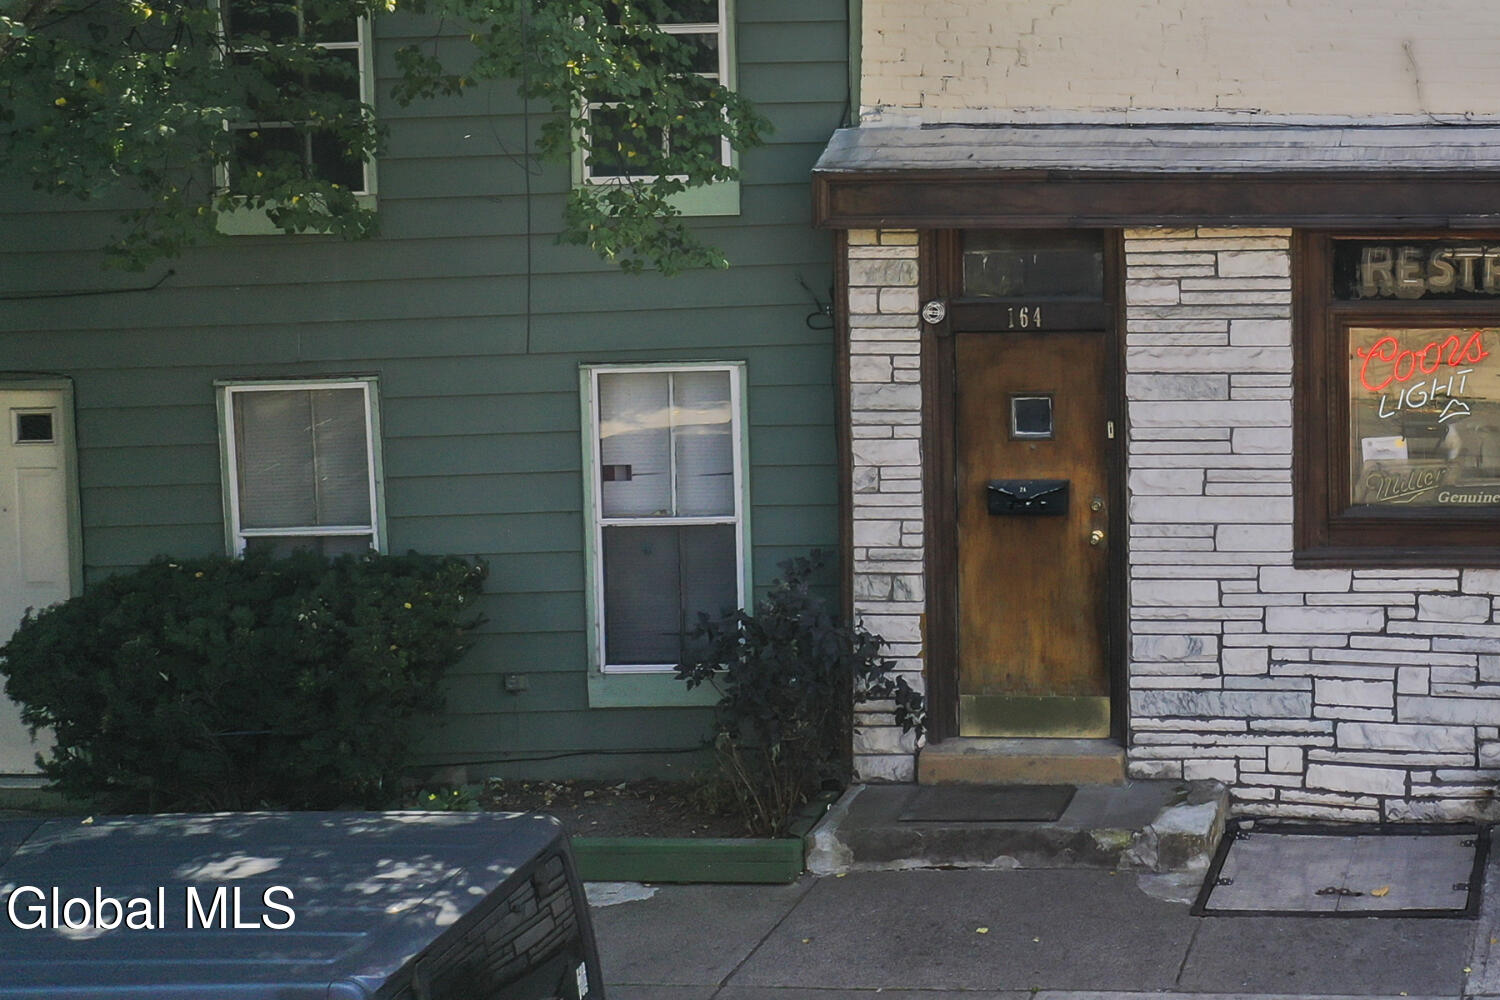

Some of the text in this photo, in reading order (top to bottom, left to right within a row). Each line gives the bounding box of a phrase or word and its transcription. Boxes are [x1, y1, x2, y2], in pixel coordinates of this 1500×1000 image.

[1007, 306, 1041, 328] 164
[1357, 331, 1489, 391] Coors
[1379, 369, 1473, 418] LIGHT
[1366, 467, 1448, 500] Miller
[1438, 491, 1500, 503] Genuine
